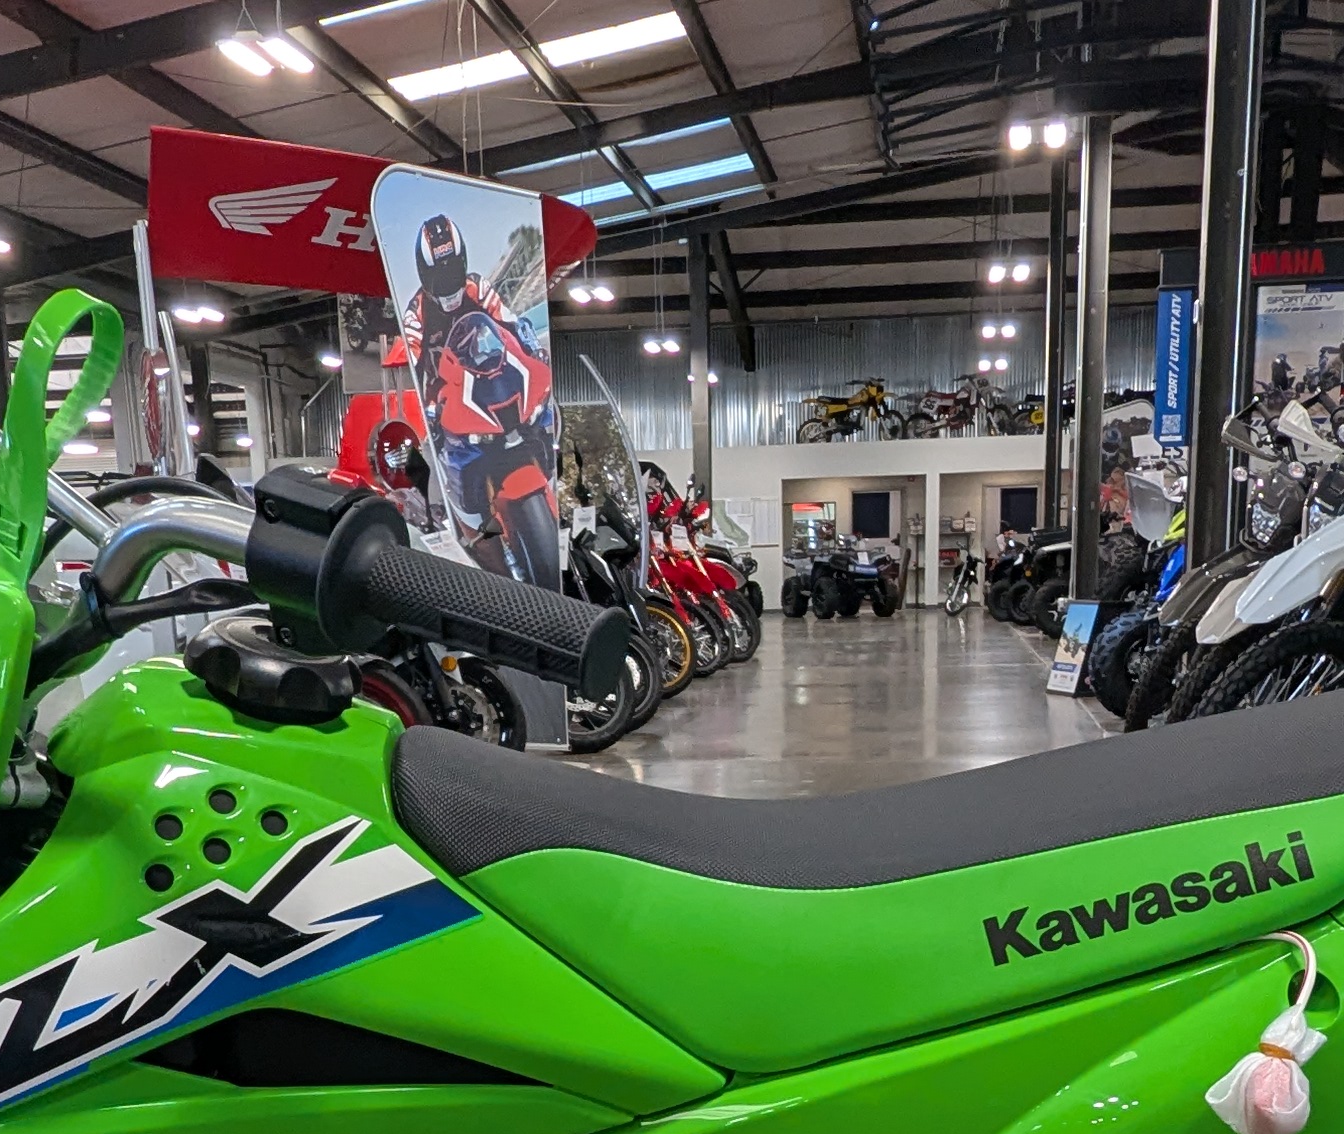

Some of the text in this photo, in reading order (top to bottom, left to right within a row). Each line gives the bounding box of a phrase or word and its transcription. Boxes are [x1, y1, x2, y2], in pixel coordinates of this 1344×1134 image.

[1170, 293, 1183, 317] ATV
[1266, 293, 1333, 305] SPORT ATV
[1169, 319, 1182, 362] UTILITY
[1167, 371, 1180, 409] SPORT
[981, 831, 1315, 967] Kawasaki
